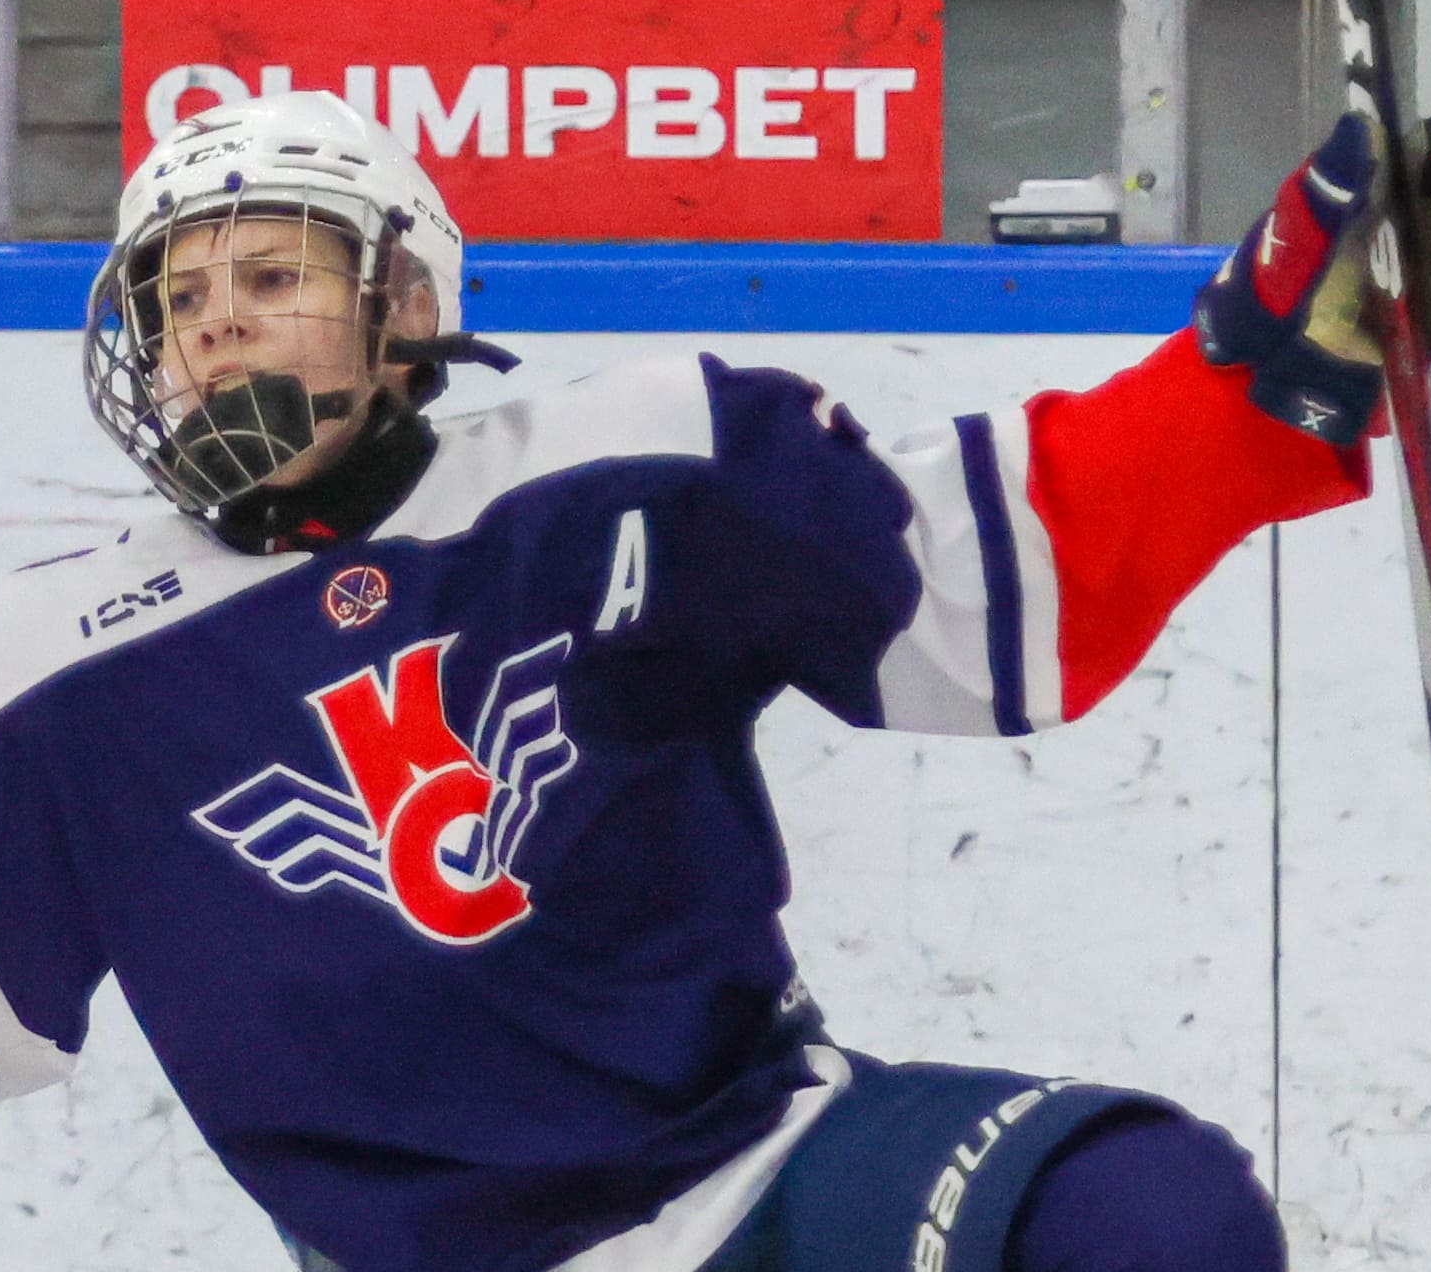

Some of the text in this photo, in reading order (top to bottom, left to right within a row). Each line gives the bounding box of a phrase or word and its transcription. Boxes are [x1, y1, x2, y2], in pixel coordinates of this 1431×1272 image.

[154, 137, 253, 179] CCM
[413, 197, 460, 245] CCM
[594, 508, 648, 633] A
